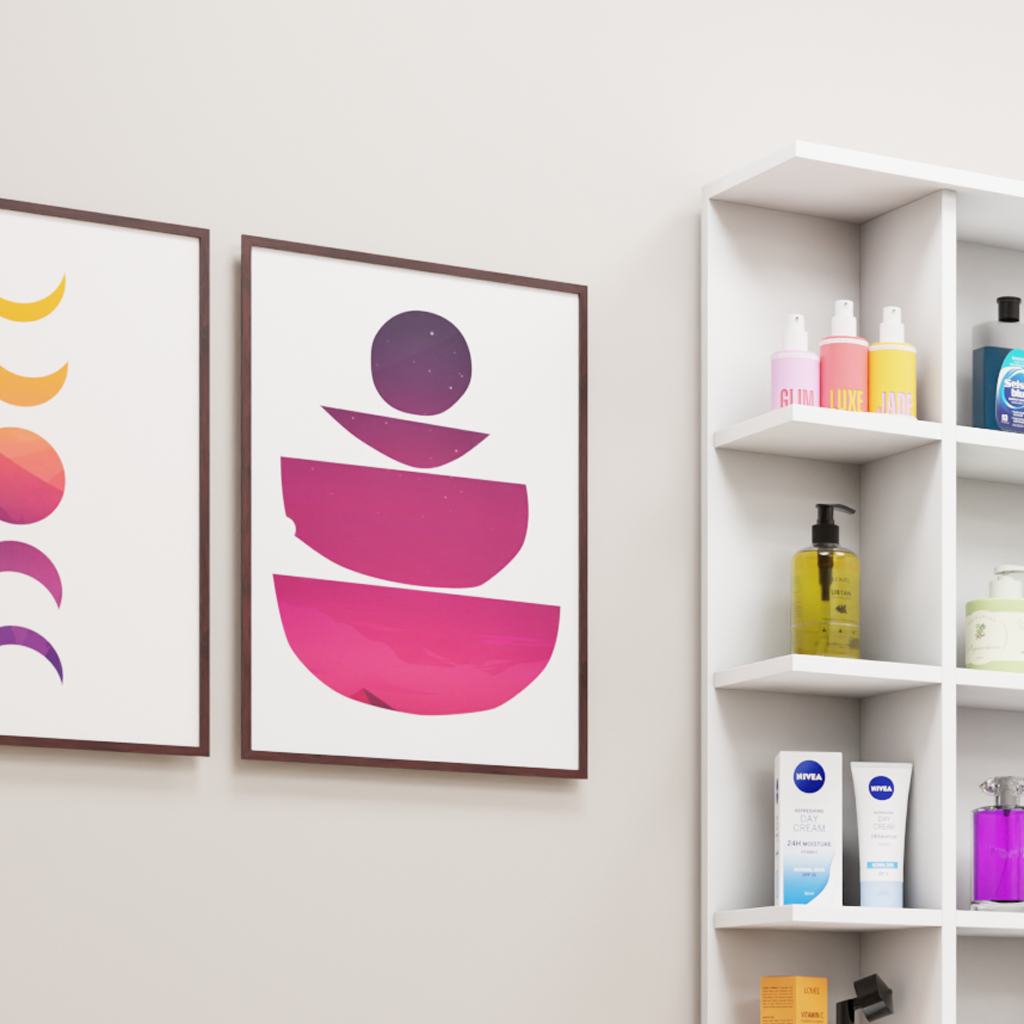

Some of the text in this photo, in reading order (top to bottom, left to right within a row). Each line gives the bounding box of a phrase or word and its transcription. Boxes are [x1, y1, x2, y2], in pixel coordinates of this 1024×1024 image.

[780, 388, 814, 408] GLIM
[830, 388, 864, 412] LUXE
[877, 391, 913, 416] JADE
[796, 772, 823, 781] NIVEA
[870, 785, 893, 793] NIVEA
[800, 814, 819, 823] DAY
[793, 823, 826, 832] CREAM
[873, 823, 896, 831] CREAM
[787, 839, 802, 847] 24H
[801, 1011, 818, 1019] VITAMIN
